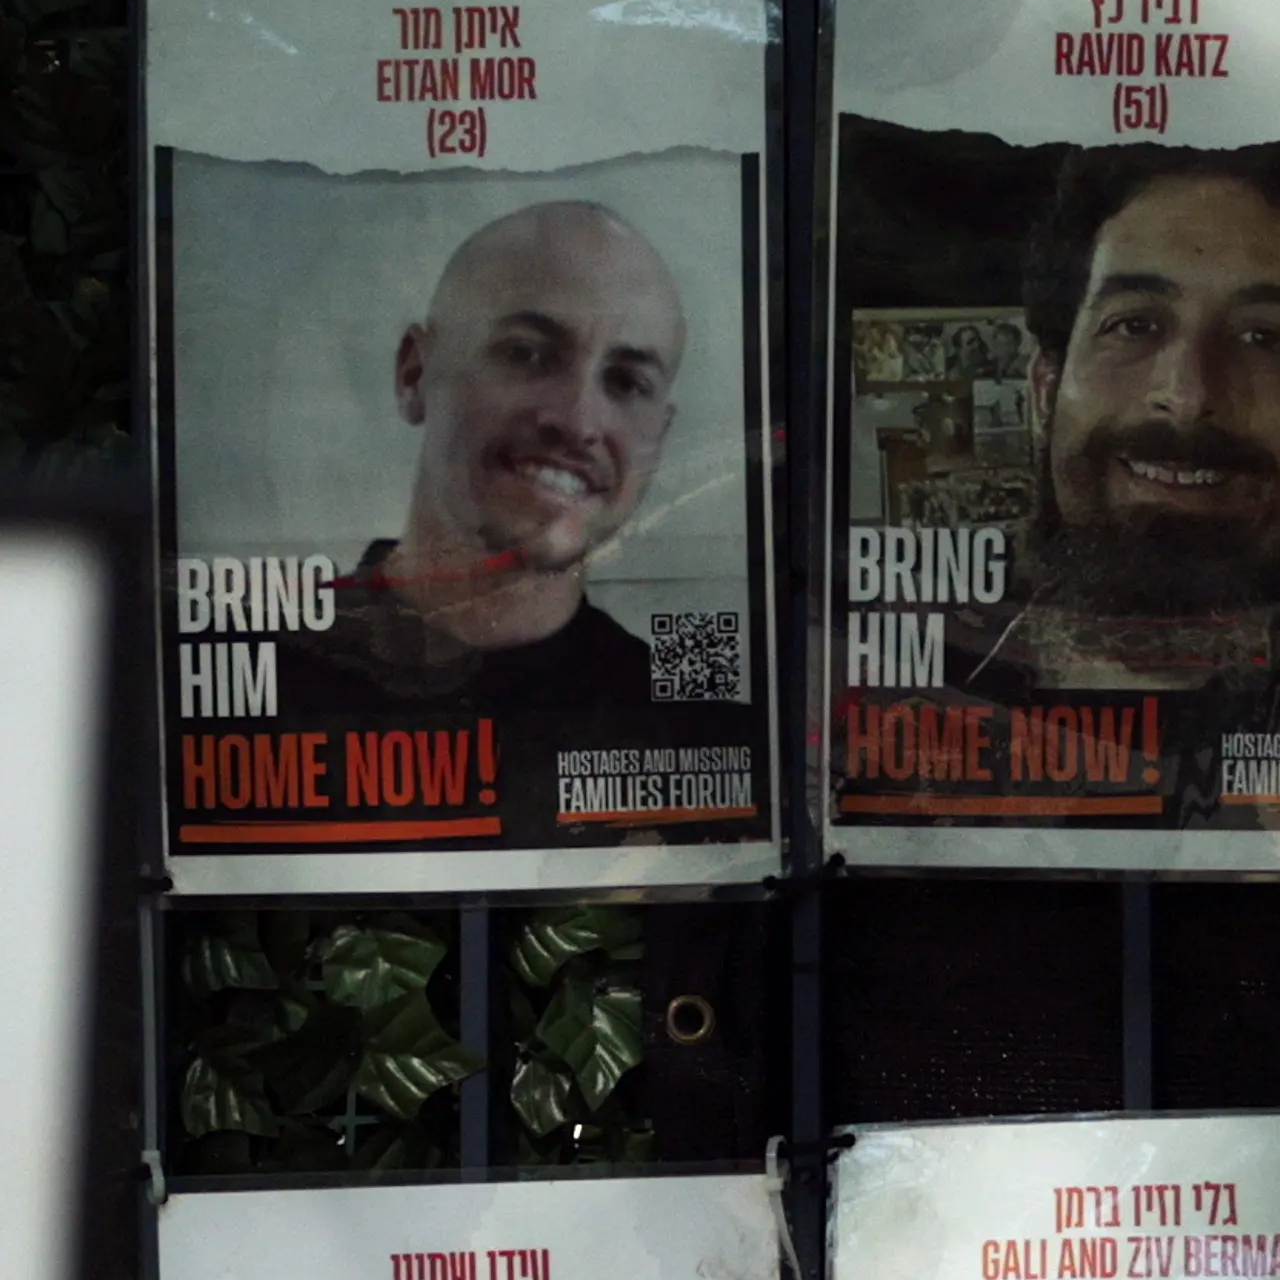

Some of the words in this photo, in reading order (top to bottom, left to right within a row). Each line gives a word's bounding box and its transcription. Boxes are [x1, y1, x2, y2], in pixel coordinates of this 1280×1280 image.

[394, 8, 442, 49] מור
[455, 6, 520, 50] איתן
[1055, 33, 1145, 77] RAVID
[1155, 33, 1228, 76] KATZ
[378, 60, 459, 101] EITAN
[470, 58, 536, 100] MOR
[1114, 84, 1167, 132] (51)
[427, 110, 485, 157] (23)
[178, 555, 335, 634] BRING
[180, 642, 278, 719] HIM
[181, 733, 329, 810] HOME
[345, 719, 497, 807] NOW!
[1056, 1185, 1121, 1231] ברמן
[1133, 1185, 1181, 1225] וזיו
[1192, 1182, 1238, 1225] גלי
[983, 1240, 1047, 1280] GALI
[1059, 1238, 1118, 1279] AND
[1127, 1237, 1174, 1278] ZIV
